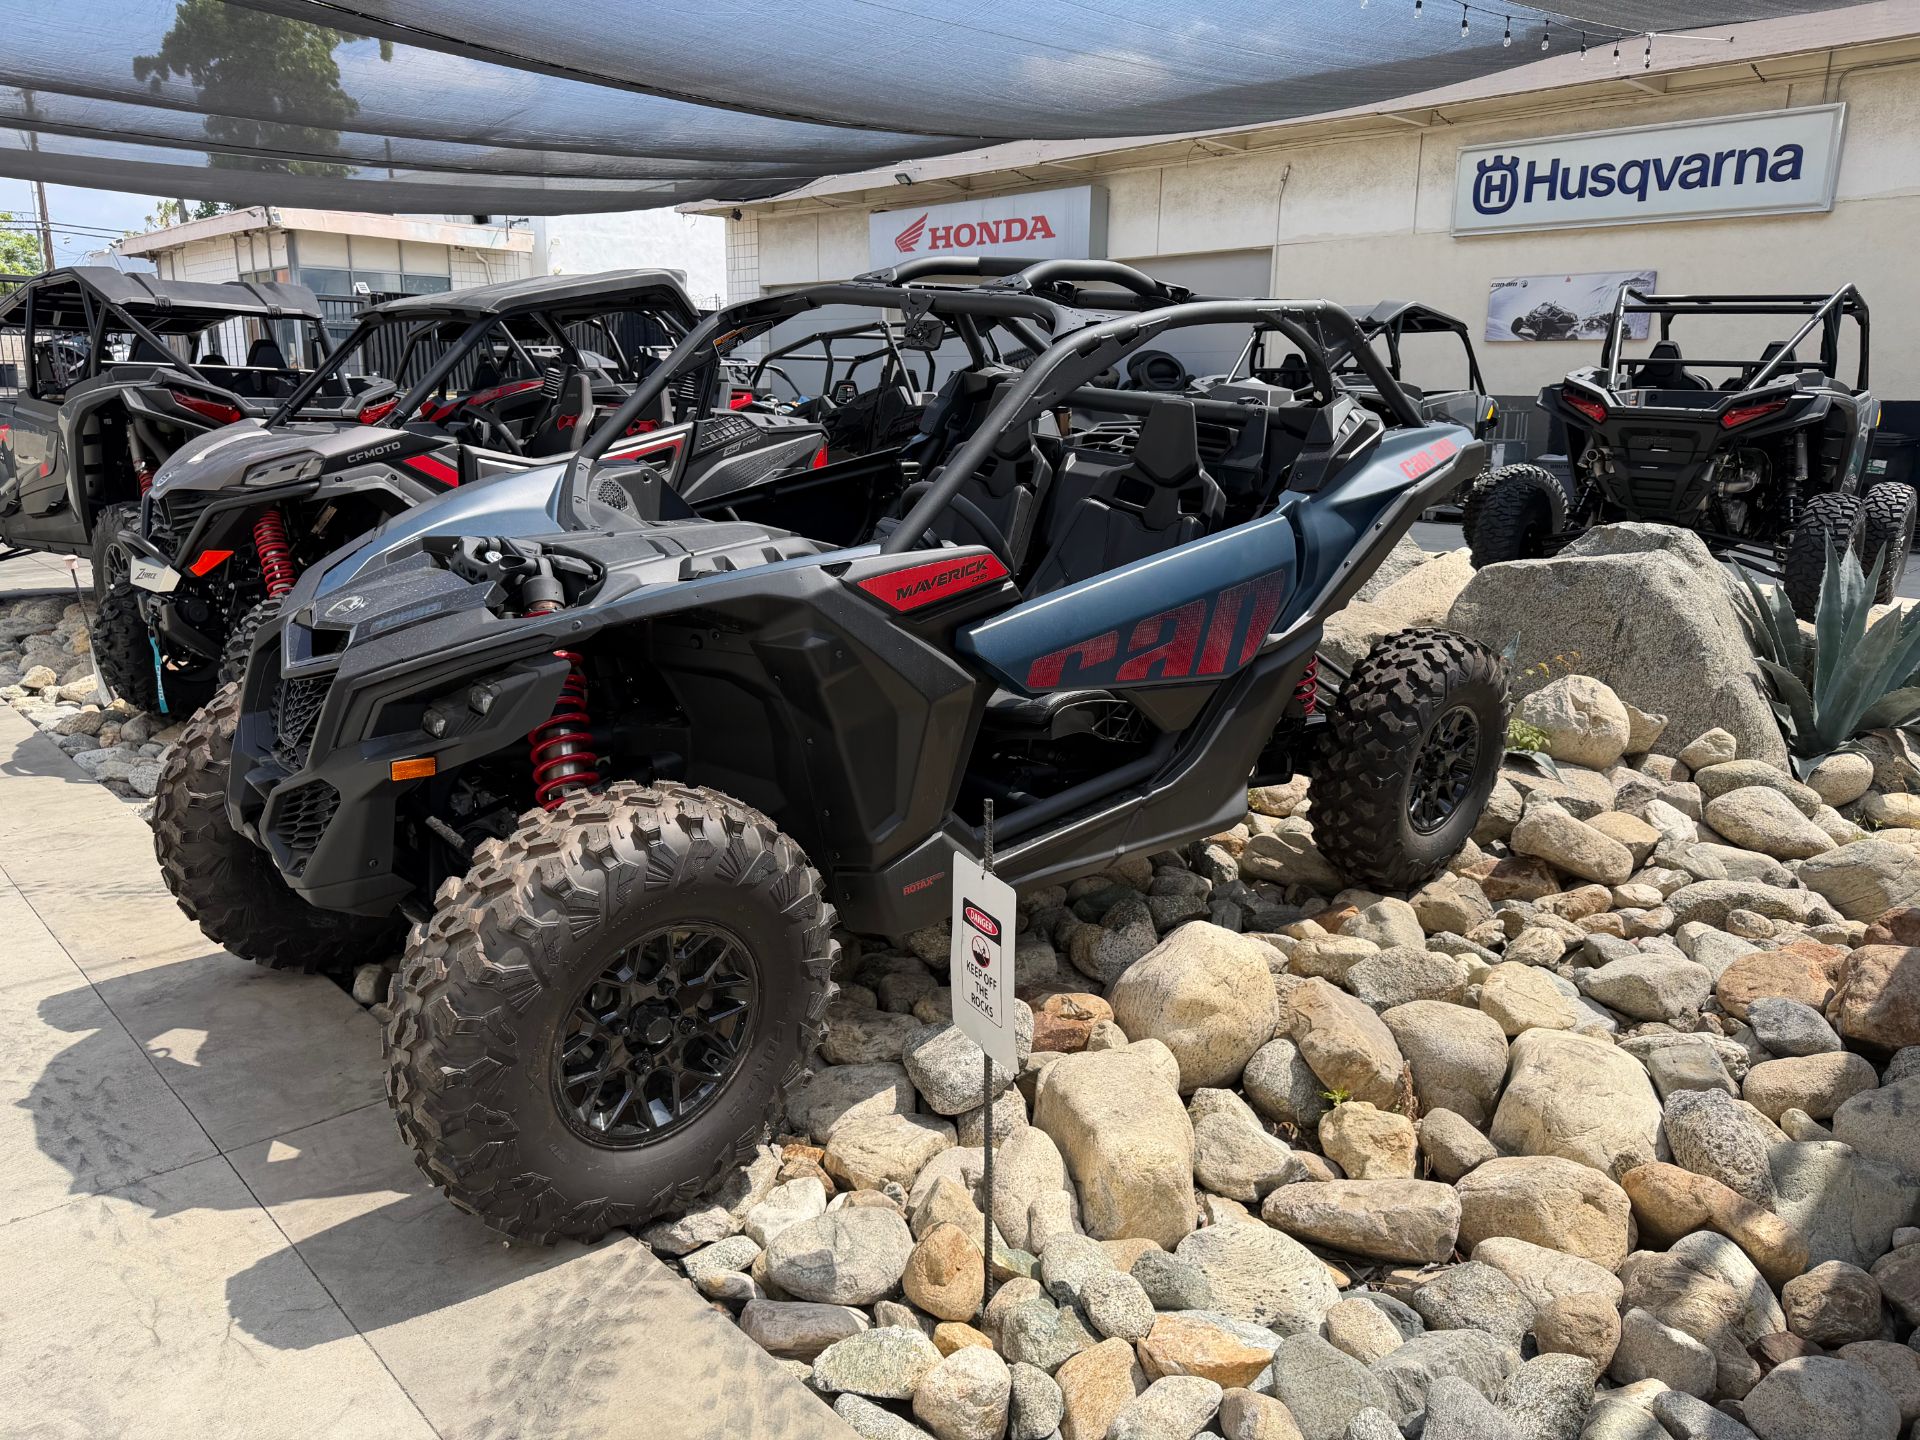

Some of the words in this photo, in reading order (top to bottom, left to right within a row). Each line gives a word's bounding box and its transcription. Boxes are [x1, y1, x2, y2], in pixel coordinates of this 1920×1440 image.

[1523, 143, 1804, 204] Husqvarna
[928, 215, 1056, 250] HONDA
[347, 441, 400, 463] CFMOTO
[895, 558, 988, 601] MAVERICK
[902, 877, 934, 896] ROTAX
[969, 909, 993, 933] DANGER
[966, 959, 983, 982] KEEP
[983, 970, 998, 991] OFF
[975, 981, 989, 1000] THE
[970, 992, 994, 1019] ROCKS
